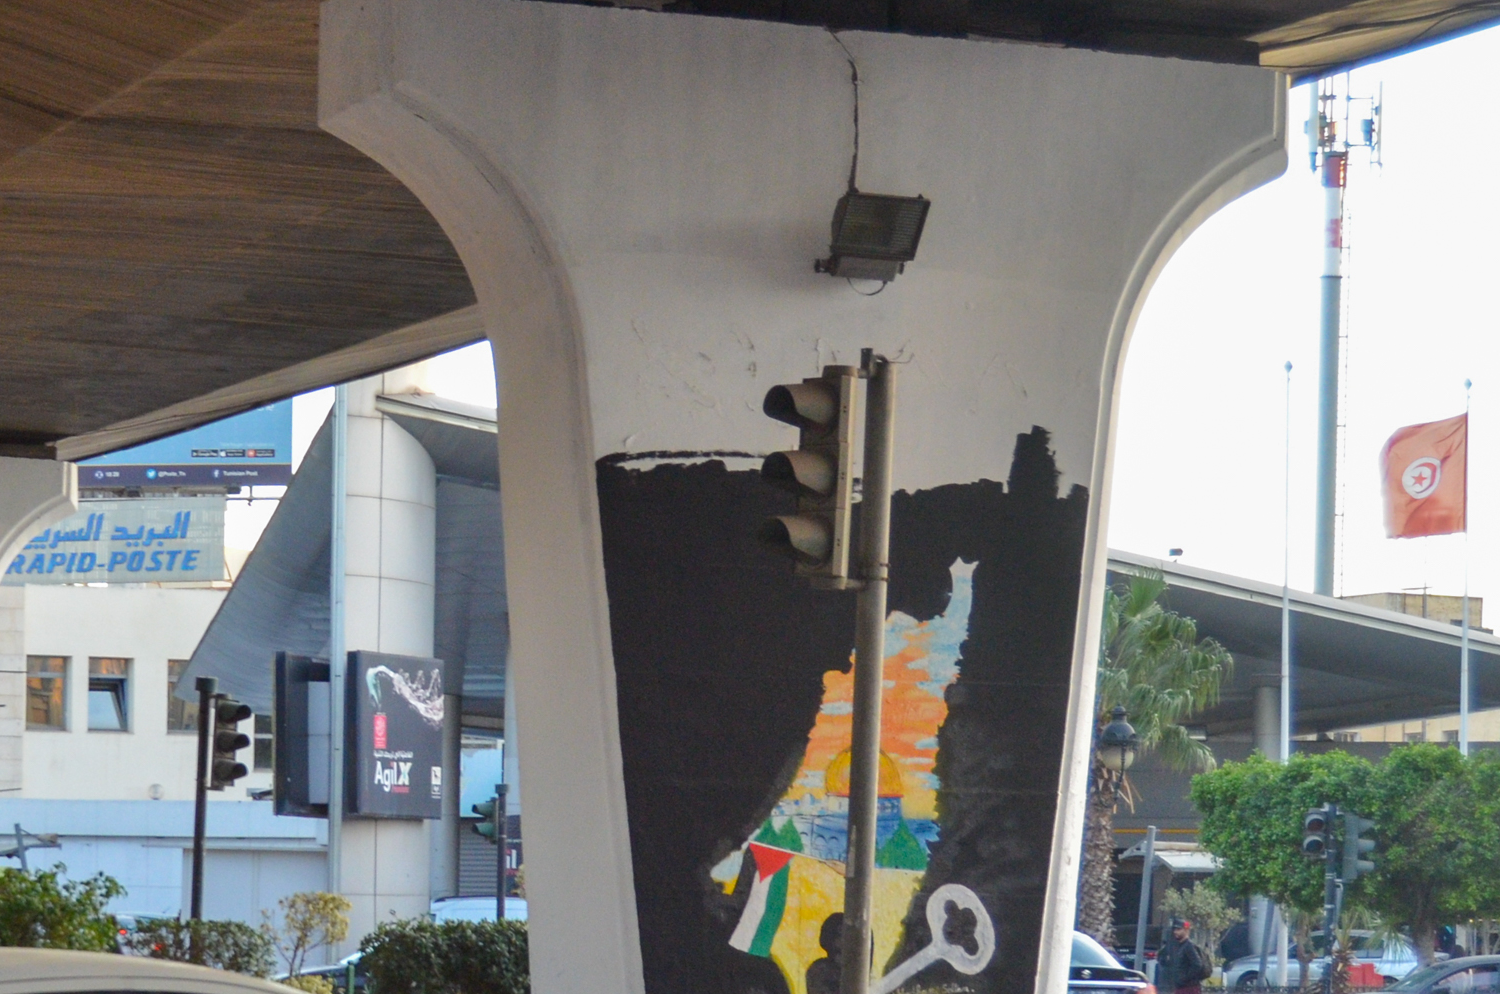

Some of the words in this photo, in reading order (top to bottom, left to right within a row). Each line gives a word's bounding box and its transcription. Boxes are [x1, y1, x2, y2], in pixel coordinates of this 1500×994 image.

[23, 513, 105, 549] السري
[111, 511, 191, 547] البريد
[5, 550, 200, 574] RAPID-POSTE
